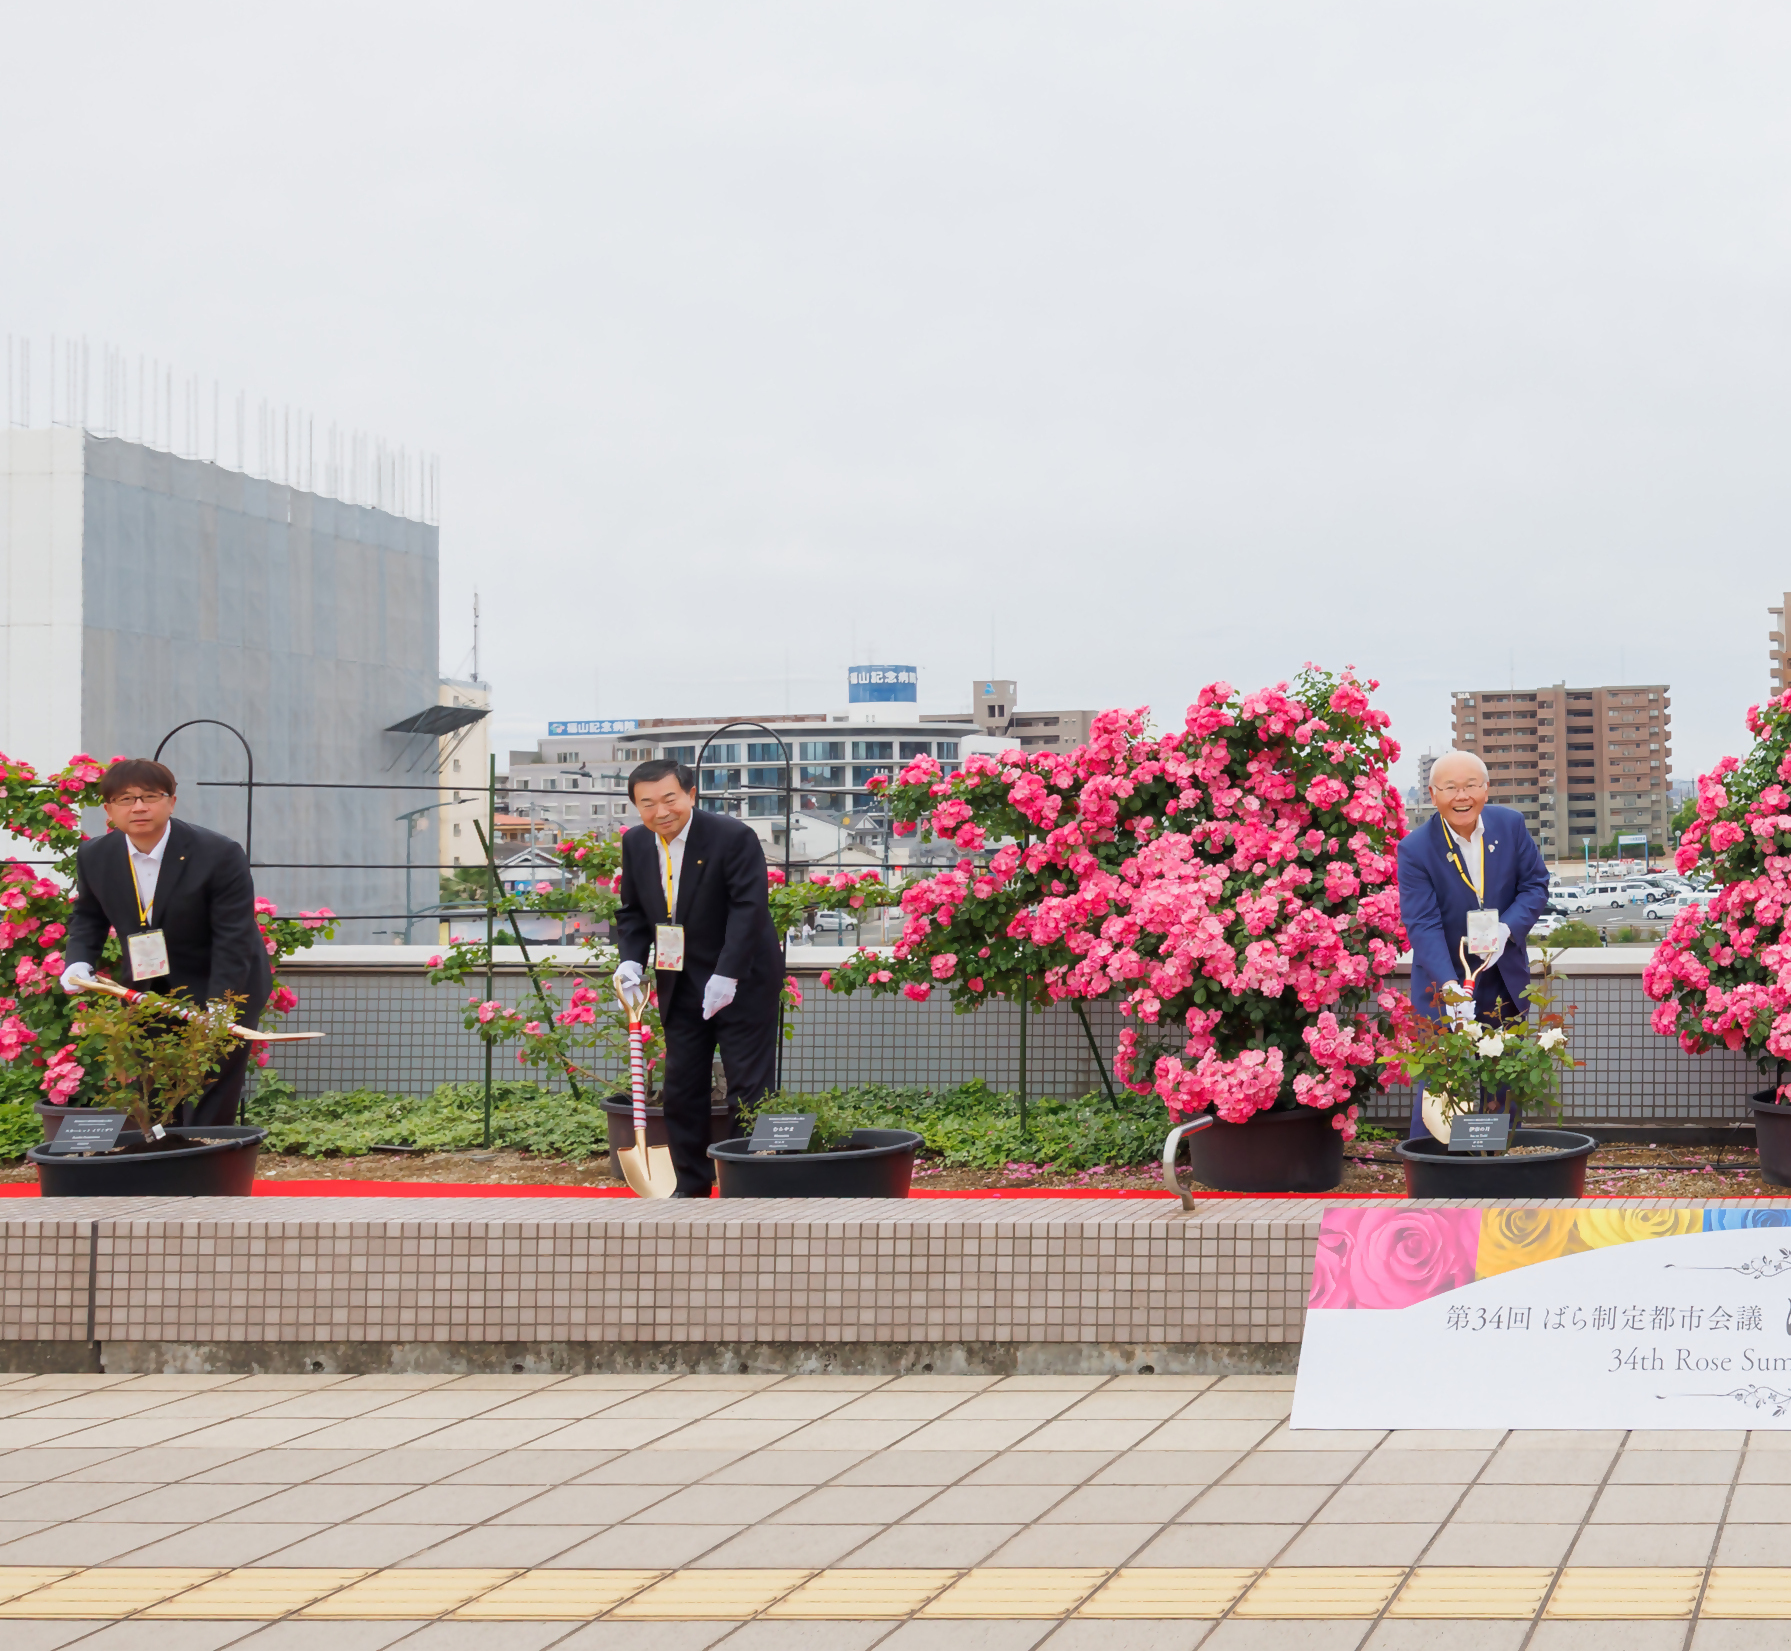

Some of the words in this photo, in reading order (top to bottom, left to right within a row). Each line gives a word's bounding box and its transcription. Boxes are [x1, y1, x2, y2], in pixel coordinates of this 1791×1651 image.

[1446, 1304, 1532, 1333] 第34回
[1543, 1304, 1764, 1332] ばら制定都市会議
[1607, 1346, 1665, 1373] 34th
[1674, 1348, 1732, 1372] Rose
